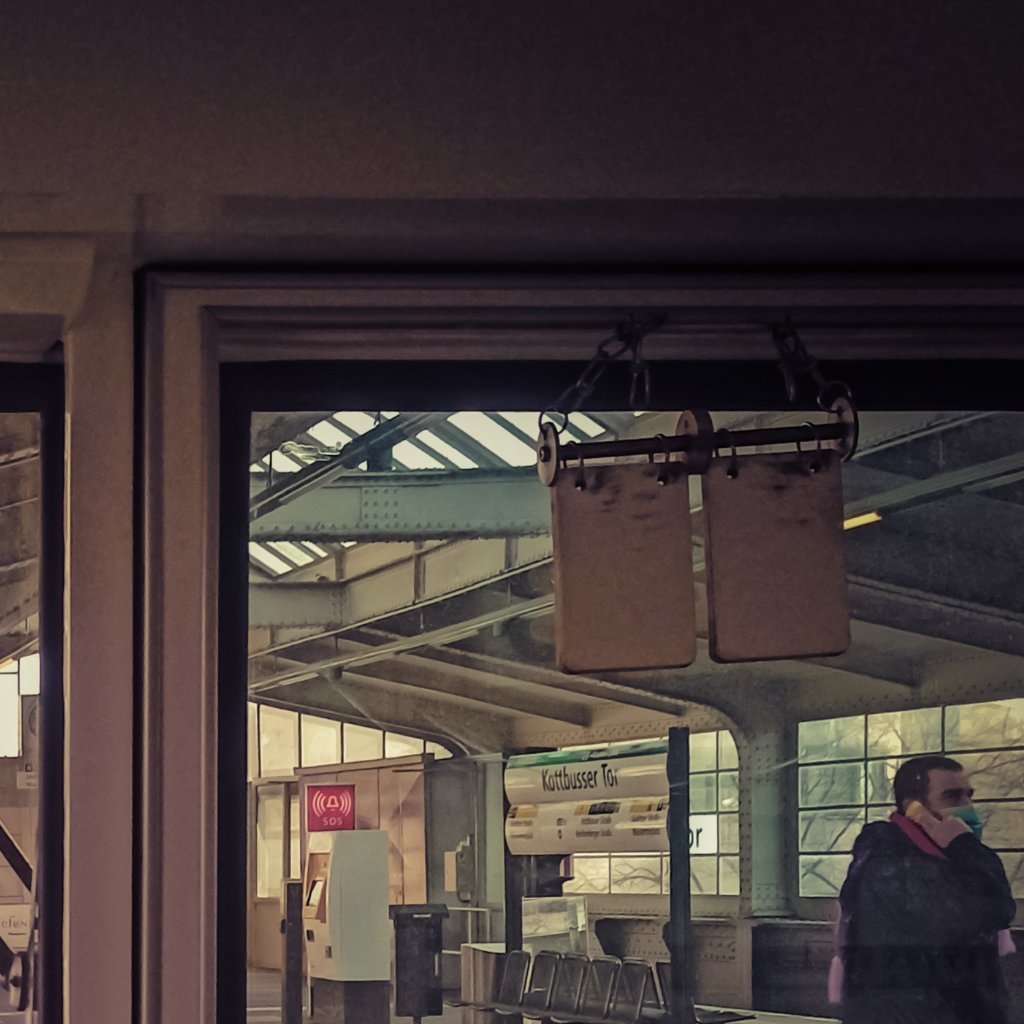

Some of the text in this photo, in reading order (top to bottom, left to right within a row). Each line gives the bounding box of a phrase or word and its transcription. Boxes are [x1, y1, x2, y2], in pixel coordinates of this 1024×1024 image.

[542, 766, 597, 792] Kottbusser
[323, 817, 343, 826] SOS
[688, 827, 703, 848] or
